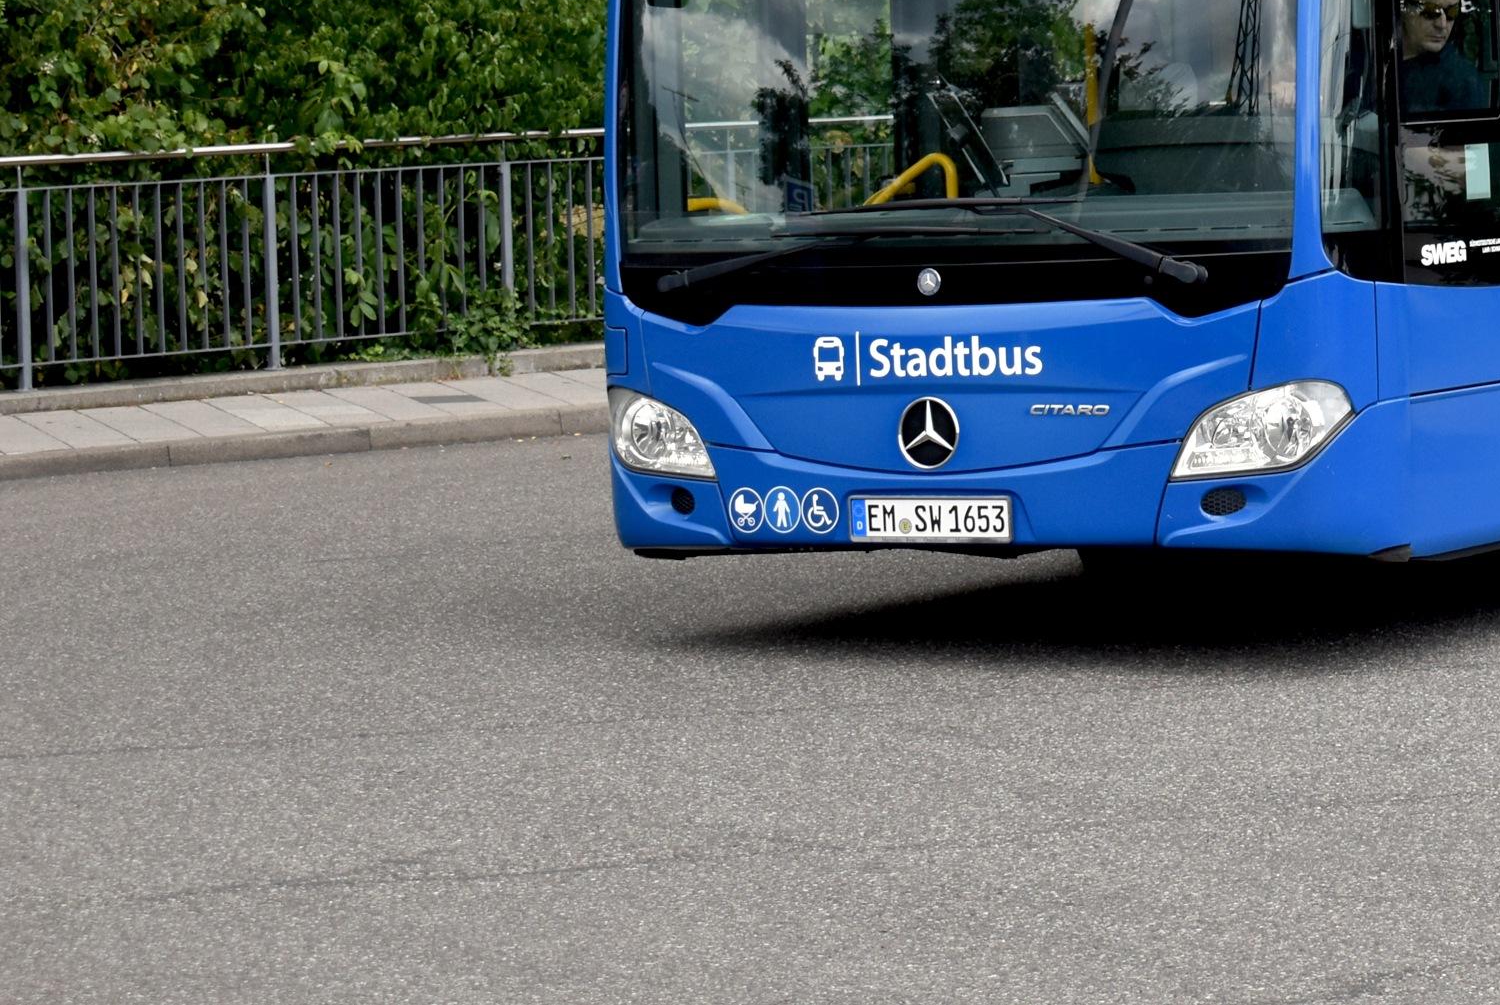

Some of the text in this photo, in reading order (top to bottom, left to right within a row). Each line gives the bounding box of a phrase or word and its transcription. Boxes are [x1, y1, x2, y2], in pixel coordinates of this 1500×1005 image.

[1420, 240, 1467, 266] SWEG
[869, 336, 1043, 377] Stadtbus
[1029, 403, 1110, 416] CITARO
[867, 504, 1005, 533] EM SW 1653
